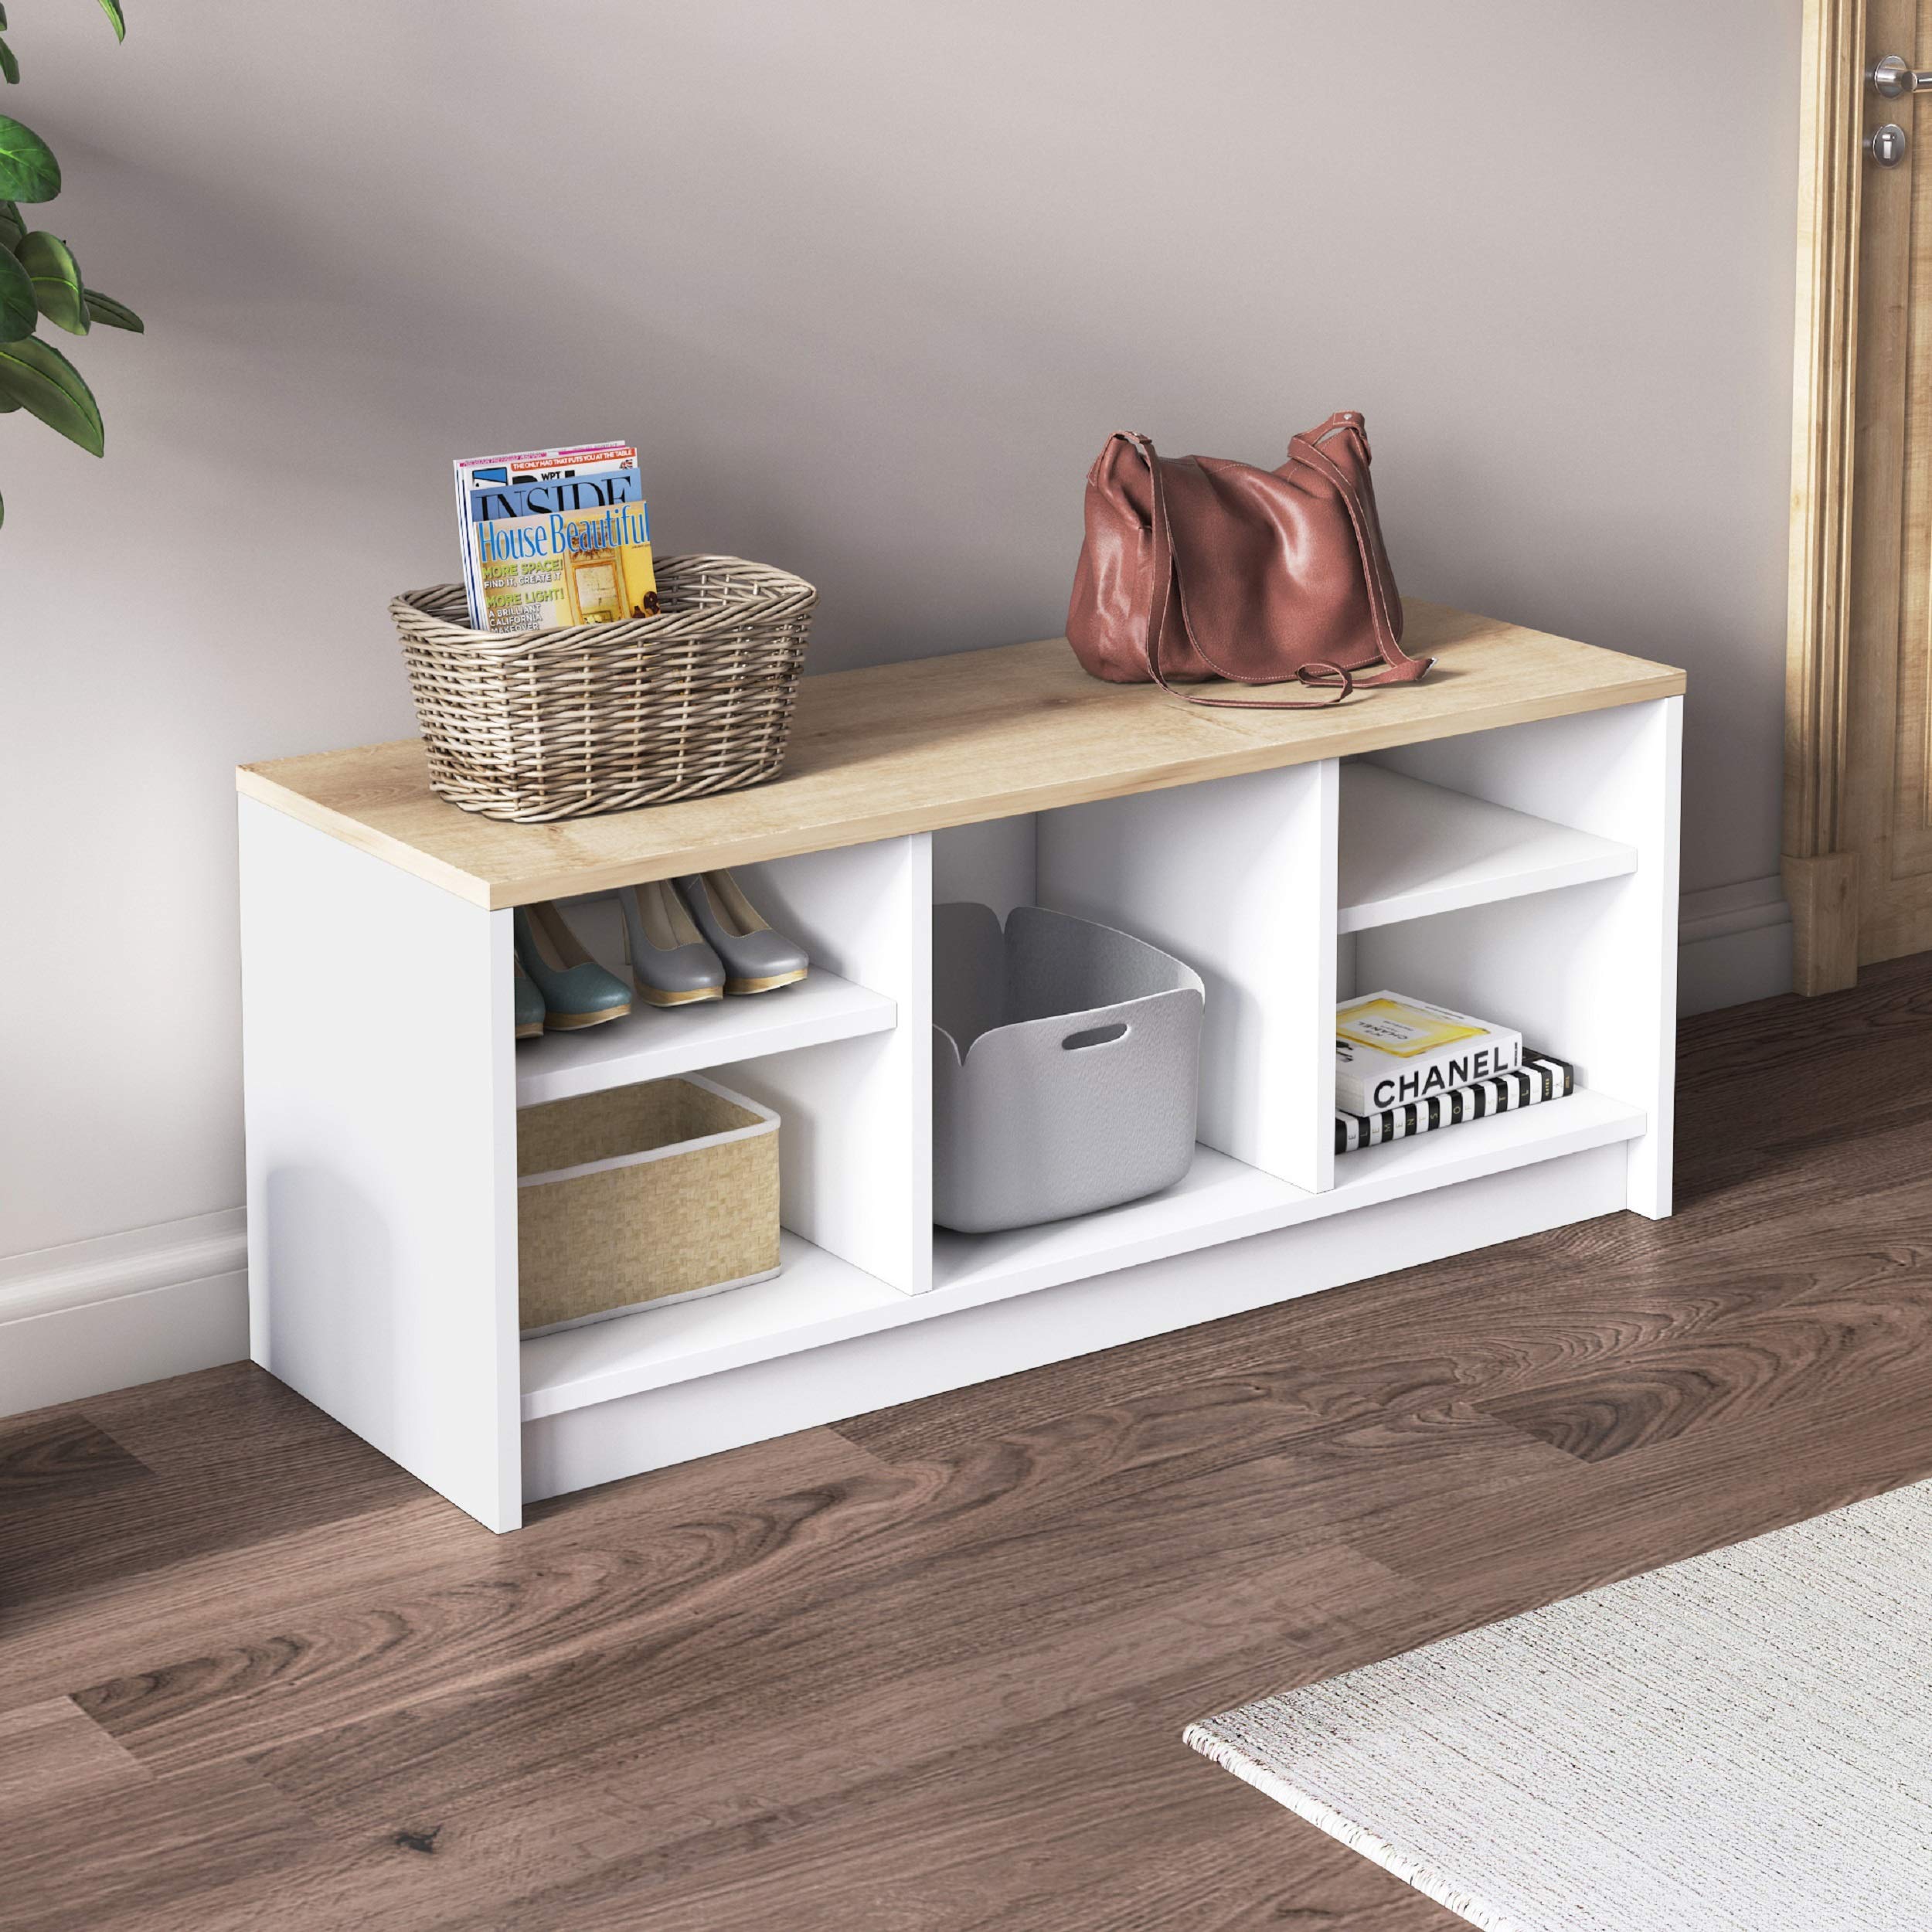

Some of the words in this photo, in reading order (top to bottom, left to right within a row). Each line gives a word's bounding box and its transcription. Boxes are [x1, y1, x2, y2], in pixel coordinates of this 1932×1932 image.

[541, 471, 561, 481] WPT
[475, 475, 631, 522] INSIDE
[479, 521, 548, 562] House
[549, 503, 650, 554] Beautiful
[482, 564, 518, 580] MORE
[521, 559, 563, 575] SPACE!
[484, 579, 505, 589] FIND
[506, 578, 517, 587] IT,
[519, 574, 552, 584] CREATE
[553, 572, 562, 580] IT
[485, 594, 522, 608] MORE
[526, 587, 564, 604] LIGHT!
[497, 604, 542, 617] BRILLIANT
[490, 614, 543, 627] CALIFORNIA
[491, 622, 540, 634] MAKEOVER
[1373, 1046, 1509, 1108] CHANEL
